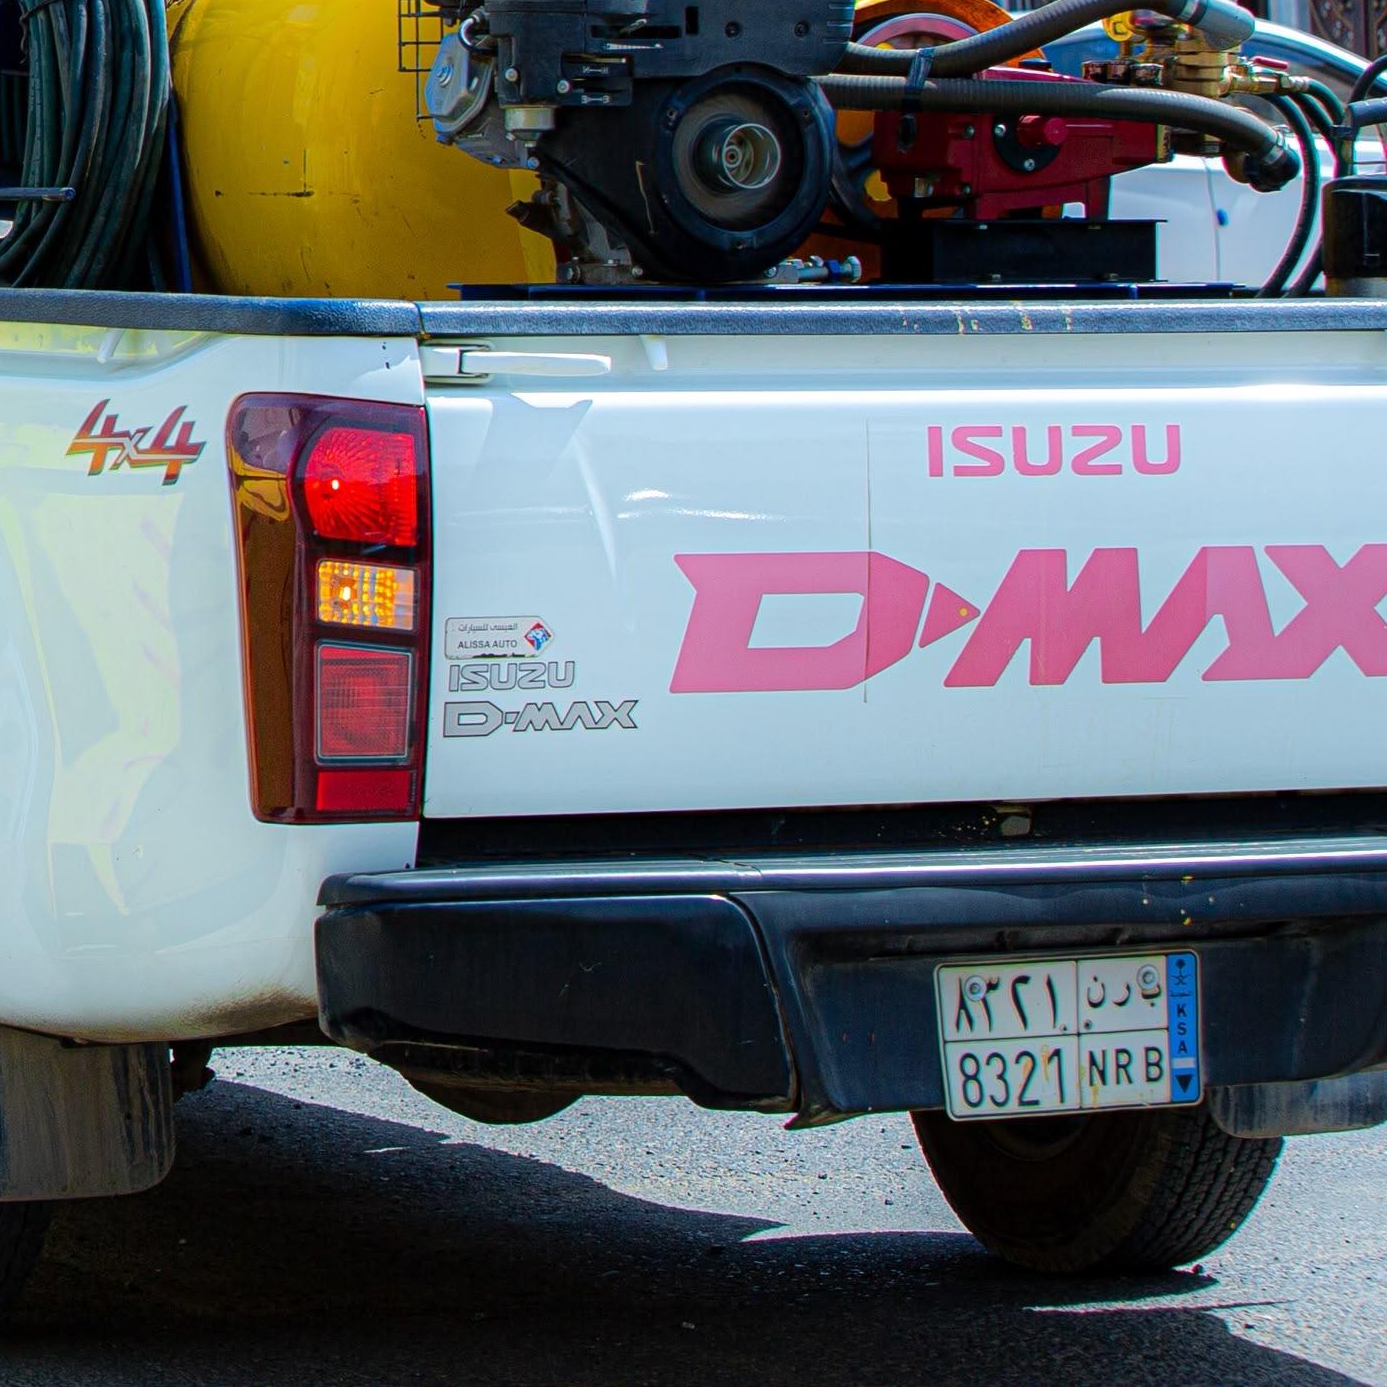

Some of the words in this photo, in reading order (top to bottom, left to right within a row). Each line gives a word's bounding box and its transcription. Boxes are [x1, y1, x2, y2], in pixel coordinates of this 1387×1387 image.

[927, 424, 1182, 477] ISUZU
[458, 640, 490, 649] ALISSA
[491, 639, 518, 649] AUTO
[448, 661, 575, 692] ISUZU
[443, 700, 639, 738] D-MAX
[959, 1047, 1065, 1108] 8321
